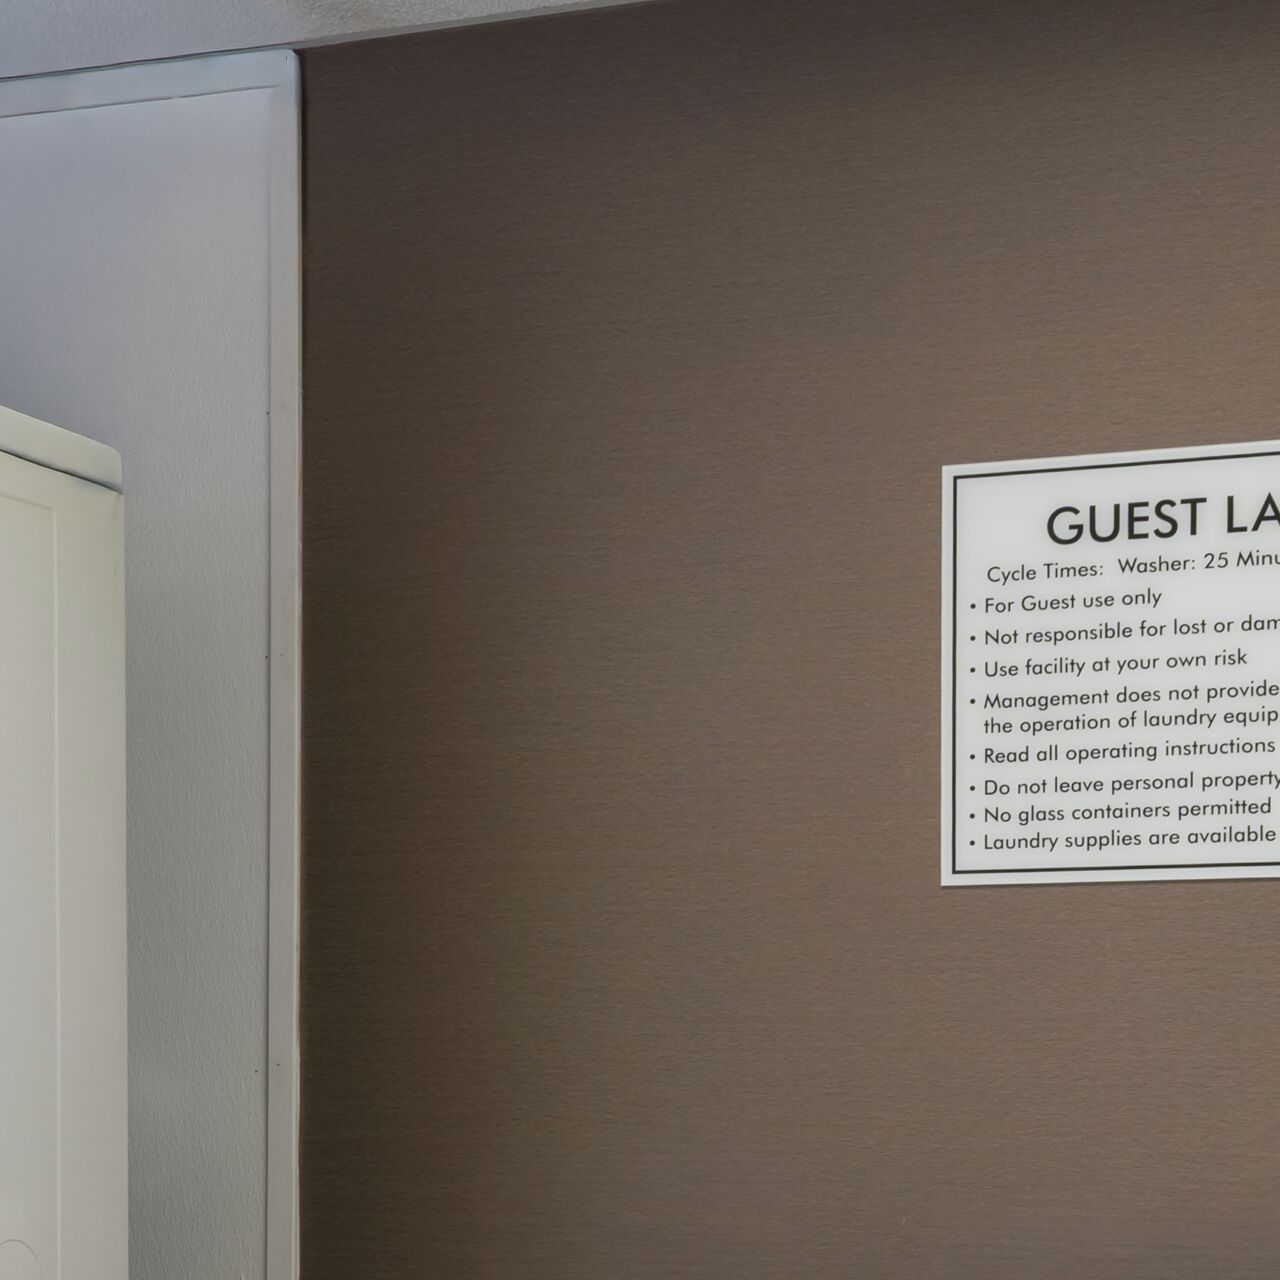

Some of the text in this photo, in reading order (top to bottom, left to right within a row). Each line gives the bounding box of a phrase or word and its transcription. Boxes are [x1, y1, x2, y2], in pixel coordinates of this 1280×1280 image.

[1046, 497, 1208, 546] GUEST
[987, 564, 1037, 586] Cycle
[1043, 562, 1103, 579] Times:
[1117, 555, 1196, 574] Washer:
[1204, 552, 1229, 569] 25
[985, 587, 1162, 614] For Guest use only
[985, 629, 1019, 645] Not
[1025, 621, 1133, 646] responsible
[1139, 619, 1167, 637] for
[1174, 618, 1207, 635] lost
[1213, 620, 1234, 633] or
[984, 647, 1247, 678] Use facility at your own risk
[983, 689, 1109, 711] Management
[1116, 686, 1161, 704] does
[1168, 685, 1200, 701] not
[1207, 679, 1280, 703] provide
[983, 717, 1013, 734] the
[1019, 713, 1111, 737] operation
[1118, 710, 1137, 729] of
[1144, 708, 1217, 729] laundry
[984, 737, 1276, 764] Read all operating instructions
[984, 779, 1011, 796] Do
[1017, 779, 1047, 794] not
[1054, 776, 1104, 793] leave
[1111, 771, 1194, 795] personal
[984, 796, 1271, 826] No glass containers permitted
[984, 831, 1059, 852] Laundry
[1064, 829, 1142, 852] supplies
[1148, 833, 1180, 845] are
[1187, 824, 1277, 844] available
